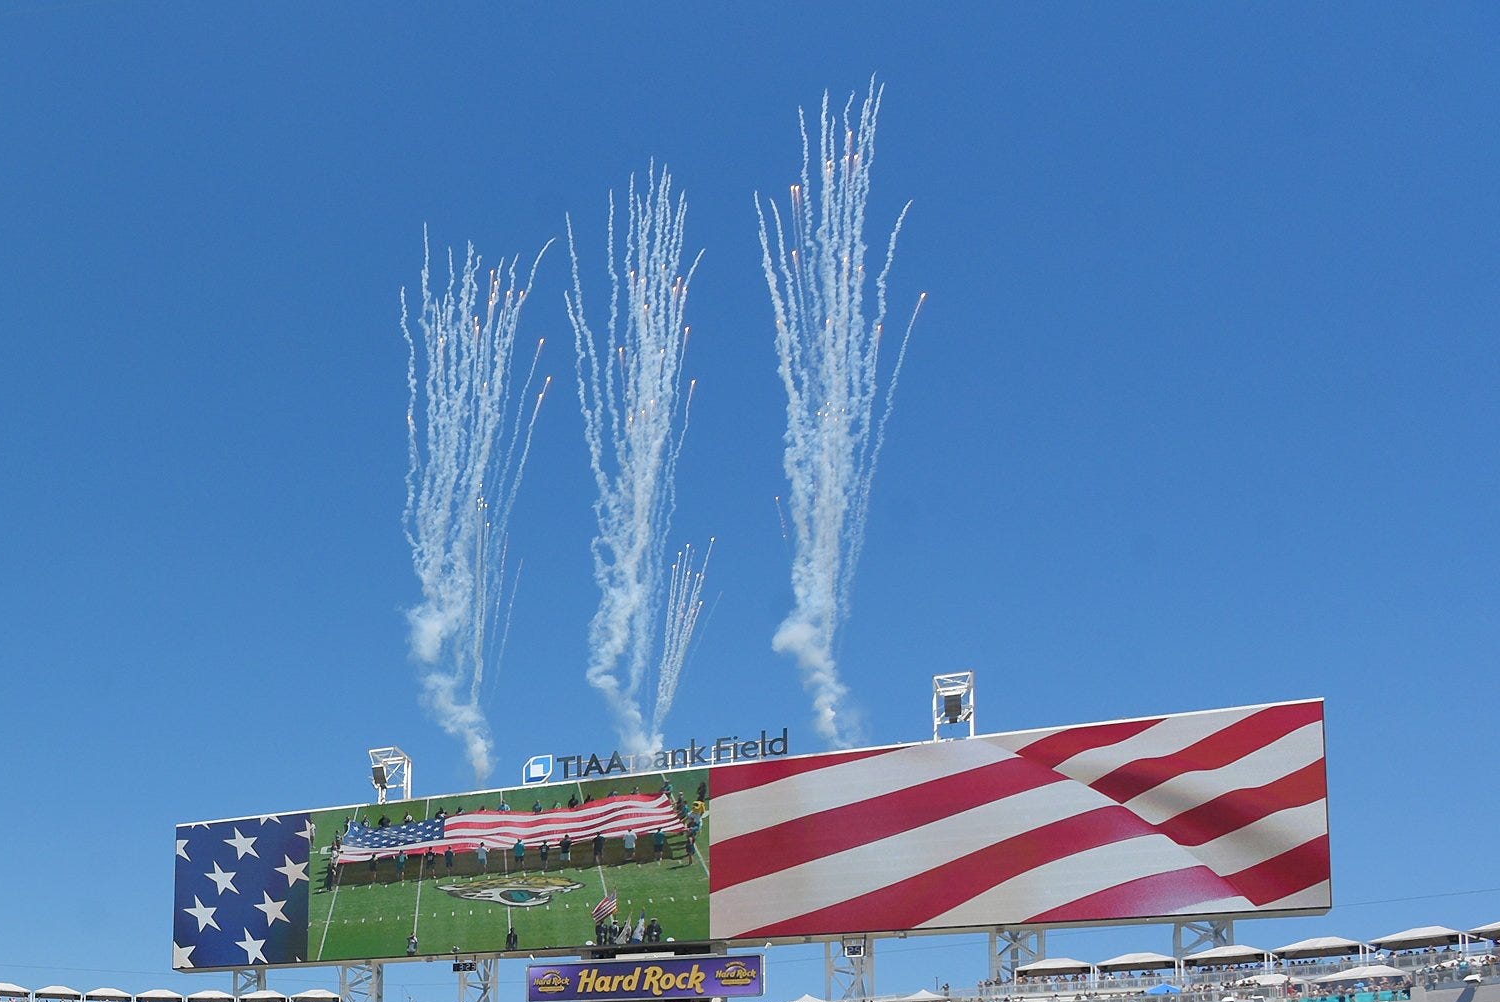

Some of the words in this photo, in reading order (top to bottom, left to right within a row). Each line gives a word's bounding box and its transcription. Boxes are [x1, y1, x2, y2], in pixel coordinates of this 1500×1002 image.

[557, 750, 627, 779] TIAA
[638, 738, 706, 772] ank
[713, 727, 788, 765] Field
[534, 977, 553, 987] Hard
[553, 976, 570, 986] Rock
[577, 966, 641, 993] Hard
[642, 963, 707, 996] Rock
[715, 970, 736, 979] Hard
[736, 968, 757, 979] Rock
